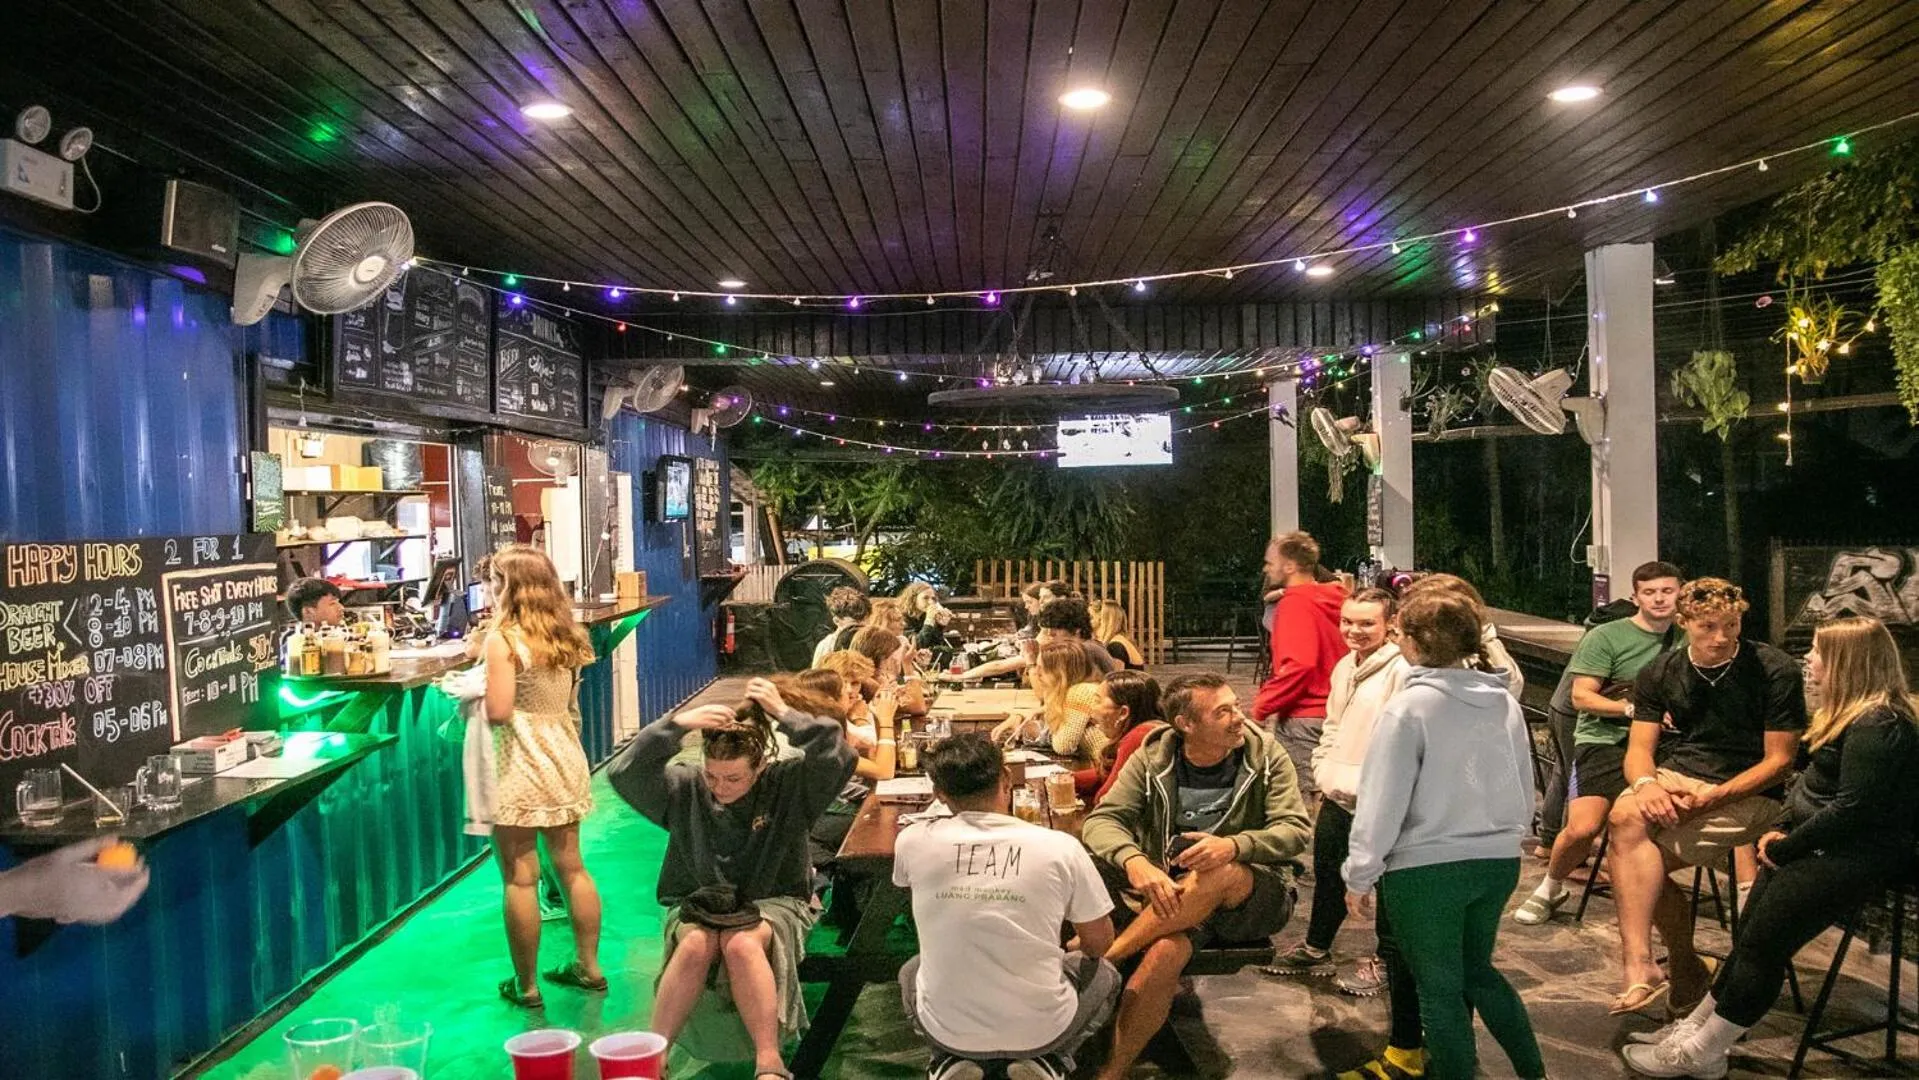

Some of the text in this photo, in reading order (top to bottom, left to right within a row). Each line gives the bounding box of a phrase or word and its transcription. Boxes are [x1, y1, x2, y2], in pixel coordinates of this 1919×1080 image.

[8, 543, 143, 588] HAPPY HOURS
[165, 535, 244, 566] 2 FOR 1
[135, 587, 157, 613] PM
[172, 584, 199, 612] FREE
[225, 580, 254, 599] EVERY
[248, 602, 264, 621] PM
[138, 610, 159, 634] PM
[84, 672, 116, 704] OFF
[240, 671, 259, 704] PM
[952, 843, 1022, 879] TEAM
